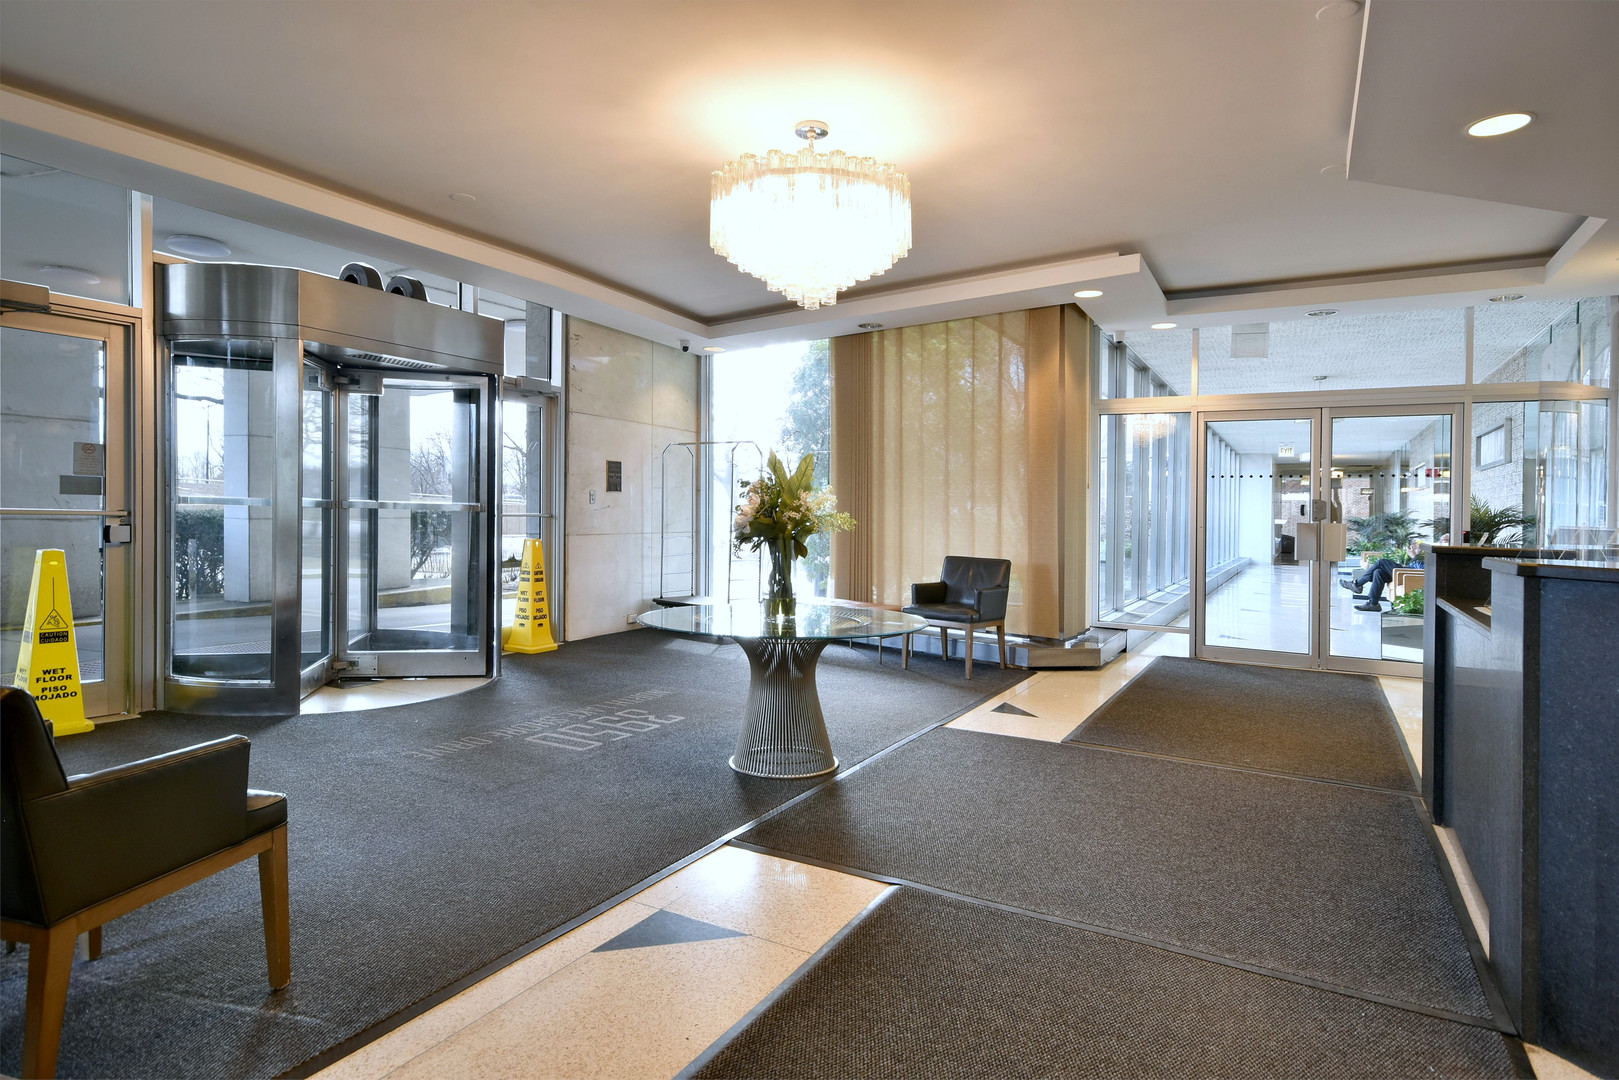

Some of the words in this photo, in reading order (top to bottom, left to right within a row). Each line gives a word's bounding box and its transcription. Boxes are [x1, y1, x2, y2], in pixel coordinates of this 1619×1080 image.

[42, 667, 66, 675] WET
[36, 674, 72, 683] FLOOR
[41, 685, 67, 693] PISO
